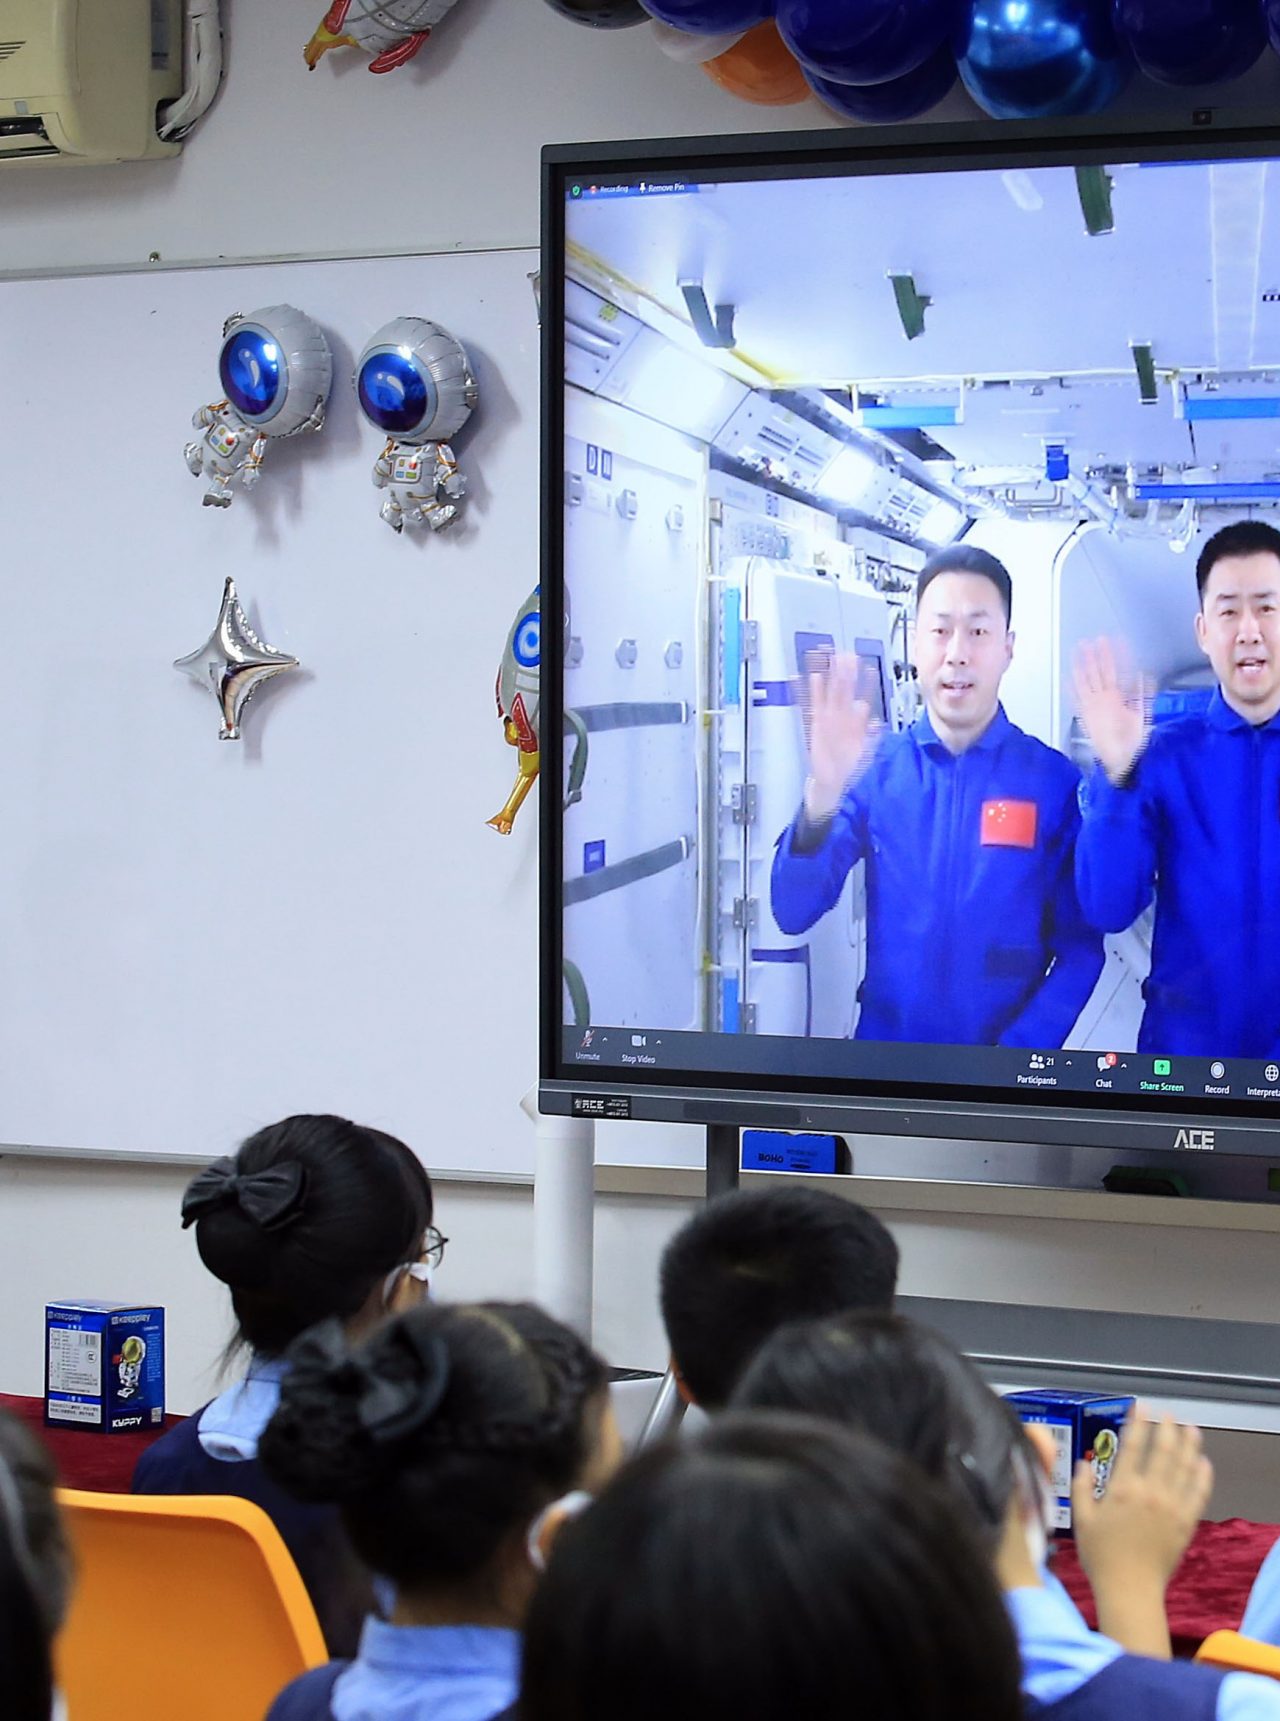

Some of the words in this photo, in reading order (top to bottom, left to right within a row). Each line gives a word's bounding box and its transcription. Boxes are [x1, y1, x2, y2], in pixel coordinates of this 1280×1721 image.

[600, 184, 629, 195] Recording
[648, 183, 674, 193] Remove
[674, 182, 685, 192] Pin
[575, 1051, 601, 1061] Unmute
[621, 1053, 637, 1065] Stop
[637, 1054, 656, 1065] Video
[1046, 1057, 1055, 1066] 21
[1017, 1074, 1058, 1087] Participants
[1095, 1078, 1113, 1089] Chat
[1139, 1081, 1160, 1092] Share
[1160, 1082, 1185, 1093] Screen
[1204, 1084, 1230, 1095] Record
[1173, 1128, 1216, 1151] ACE
